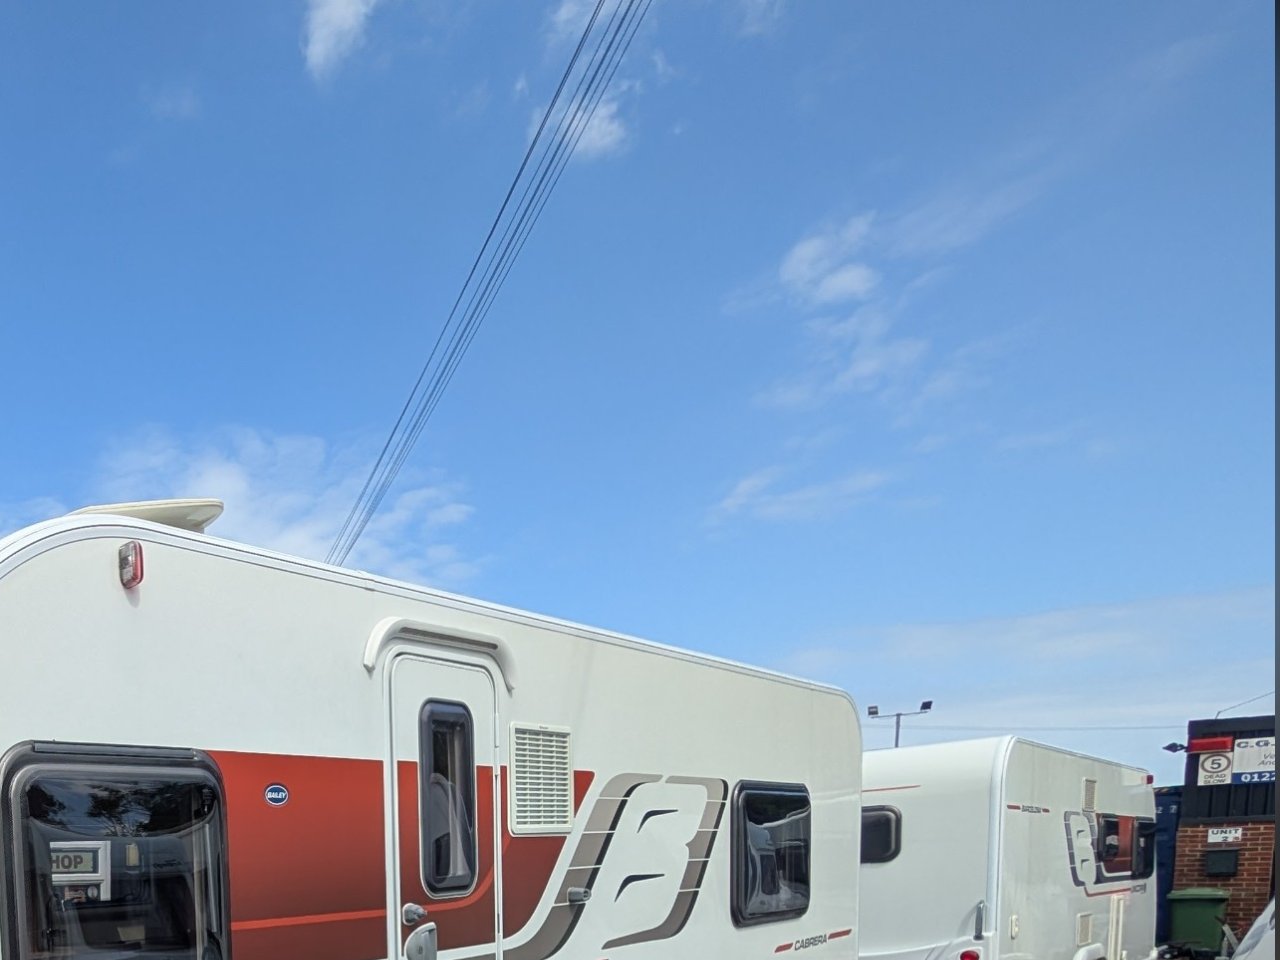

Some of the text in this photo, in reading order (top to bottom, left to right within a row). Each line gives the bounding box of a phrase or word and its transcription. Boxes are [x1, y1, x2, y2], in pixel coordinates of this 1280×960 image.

[1210, 759, 1222, 769] 5
[267, 791, 287, 799] BAILEY
[50, 854, 84, 870] HOP
[795, 934, 827, 951] CABRERA
